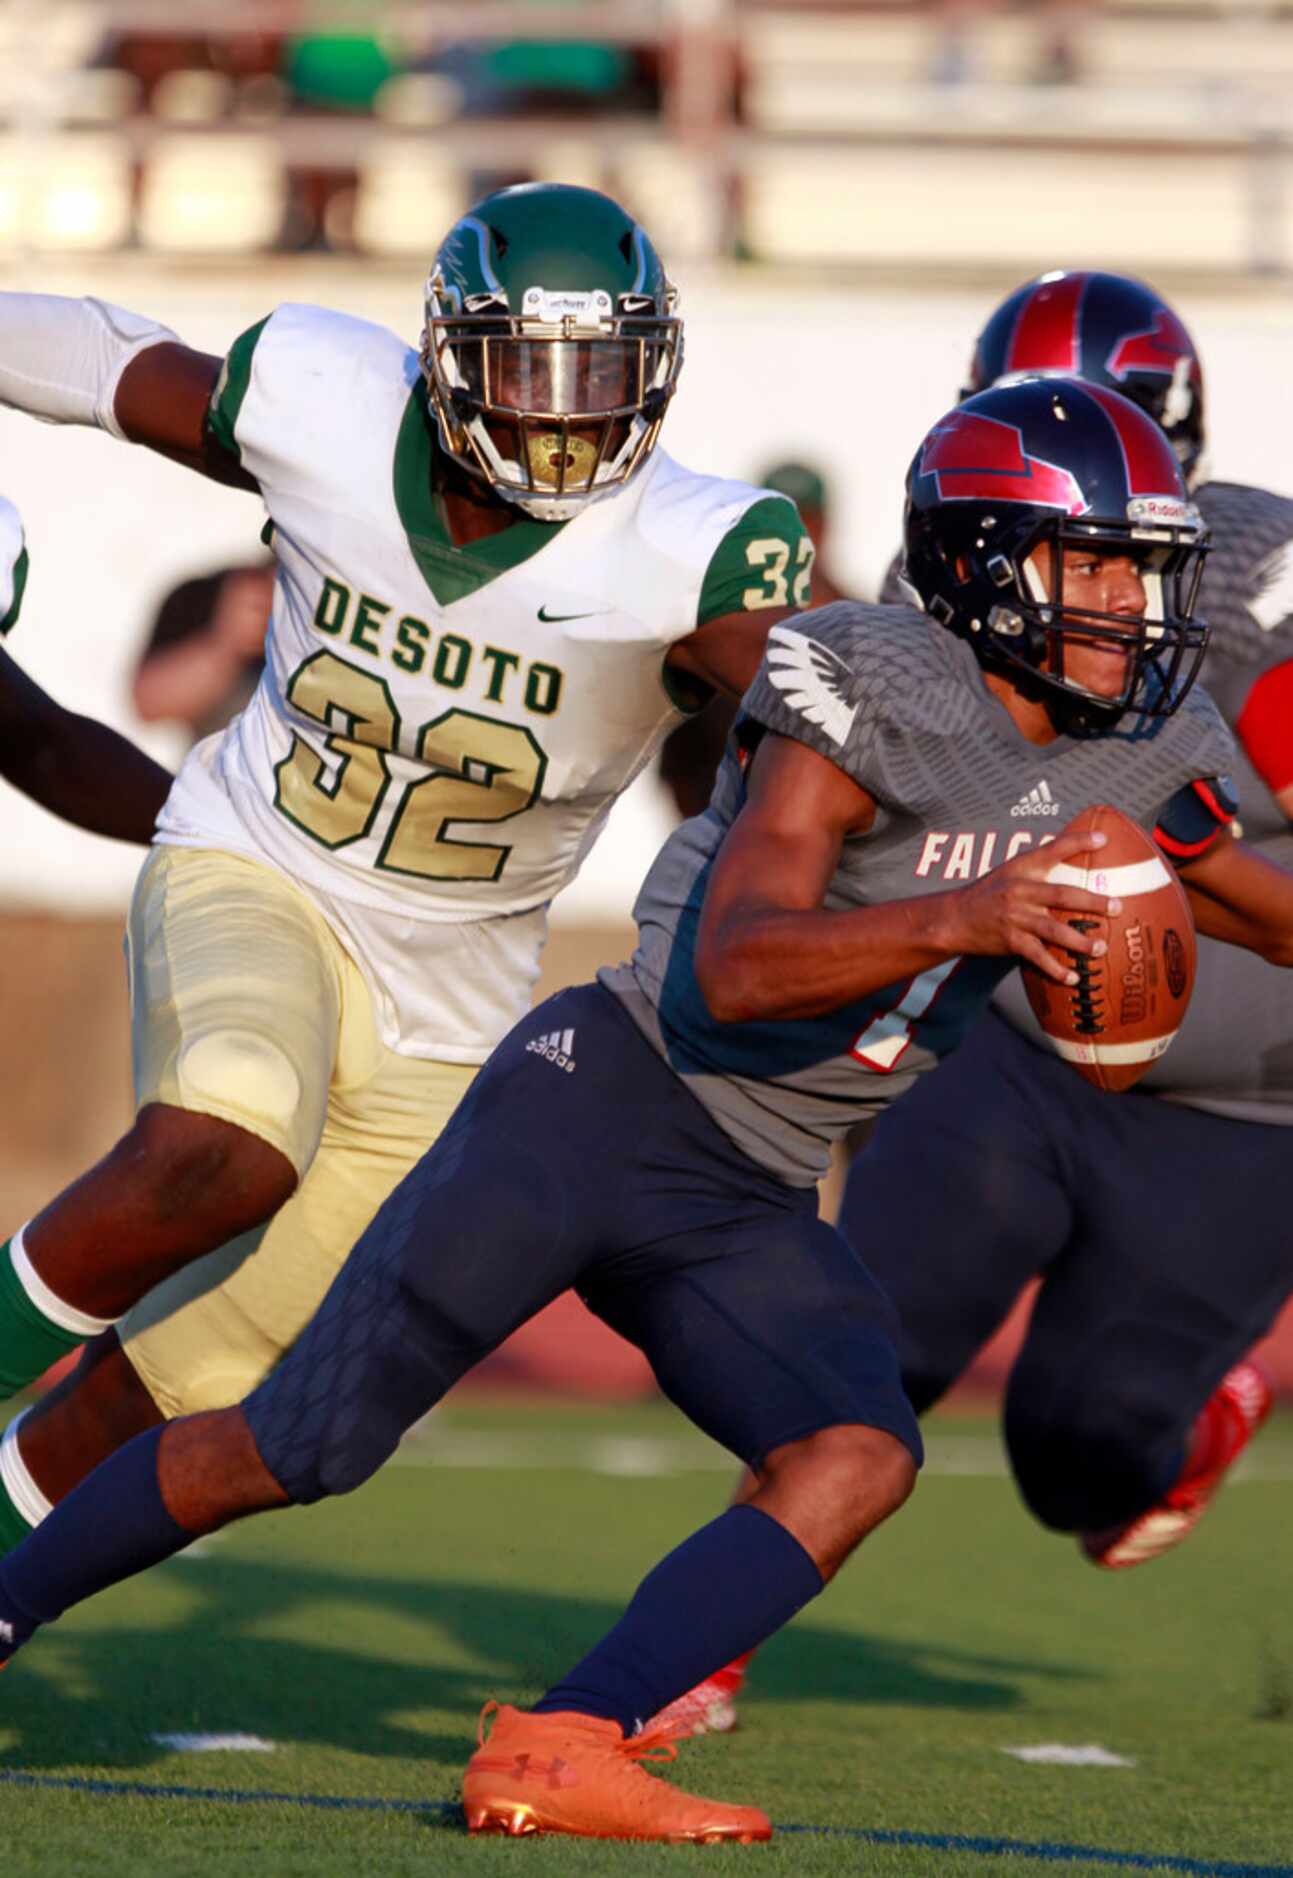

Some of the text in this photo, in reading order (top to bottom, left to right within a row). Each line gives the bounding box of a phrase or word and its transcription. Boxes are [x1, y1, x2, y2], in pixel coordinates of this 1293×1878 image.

[743, 536, 817, 612] 32
[313, 574, 565, 718] DESOTO
[273, 647, 549, 883] 32
[1010, 802, 1061, 817] adidas
[914, 829, 1057, 881] FALC
[1119, 924, 1146, 1026] Wilson
[525, 1040, 577, 1073] adidas
